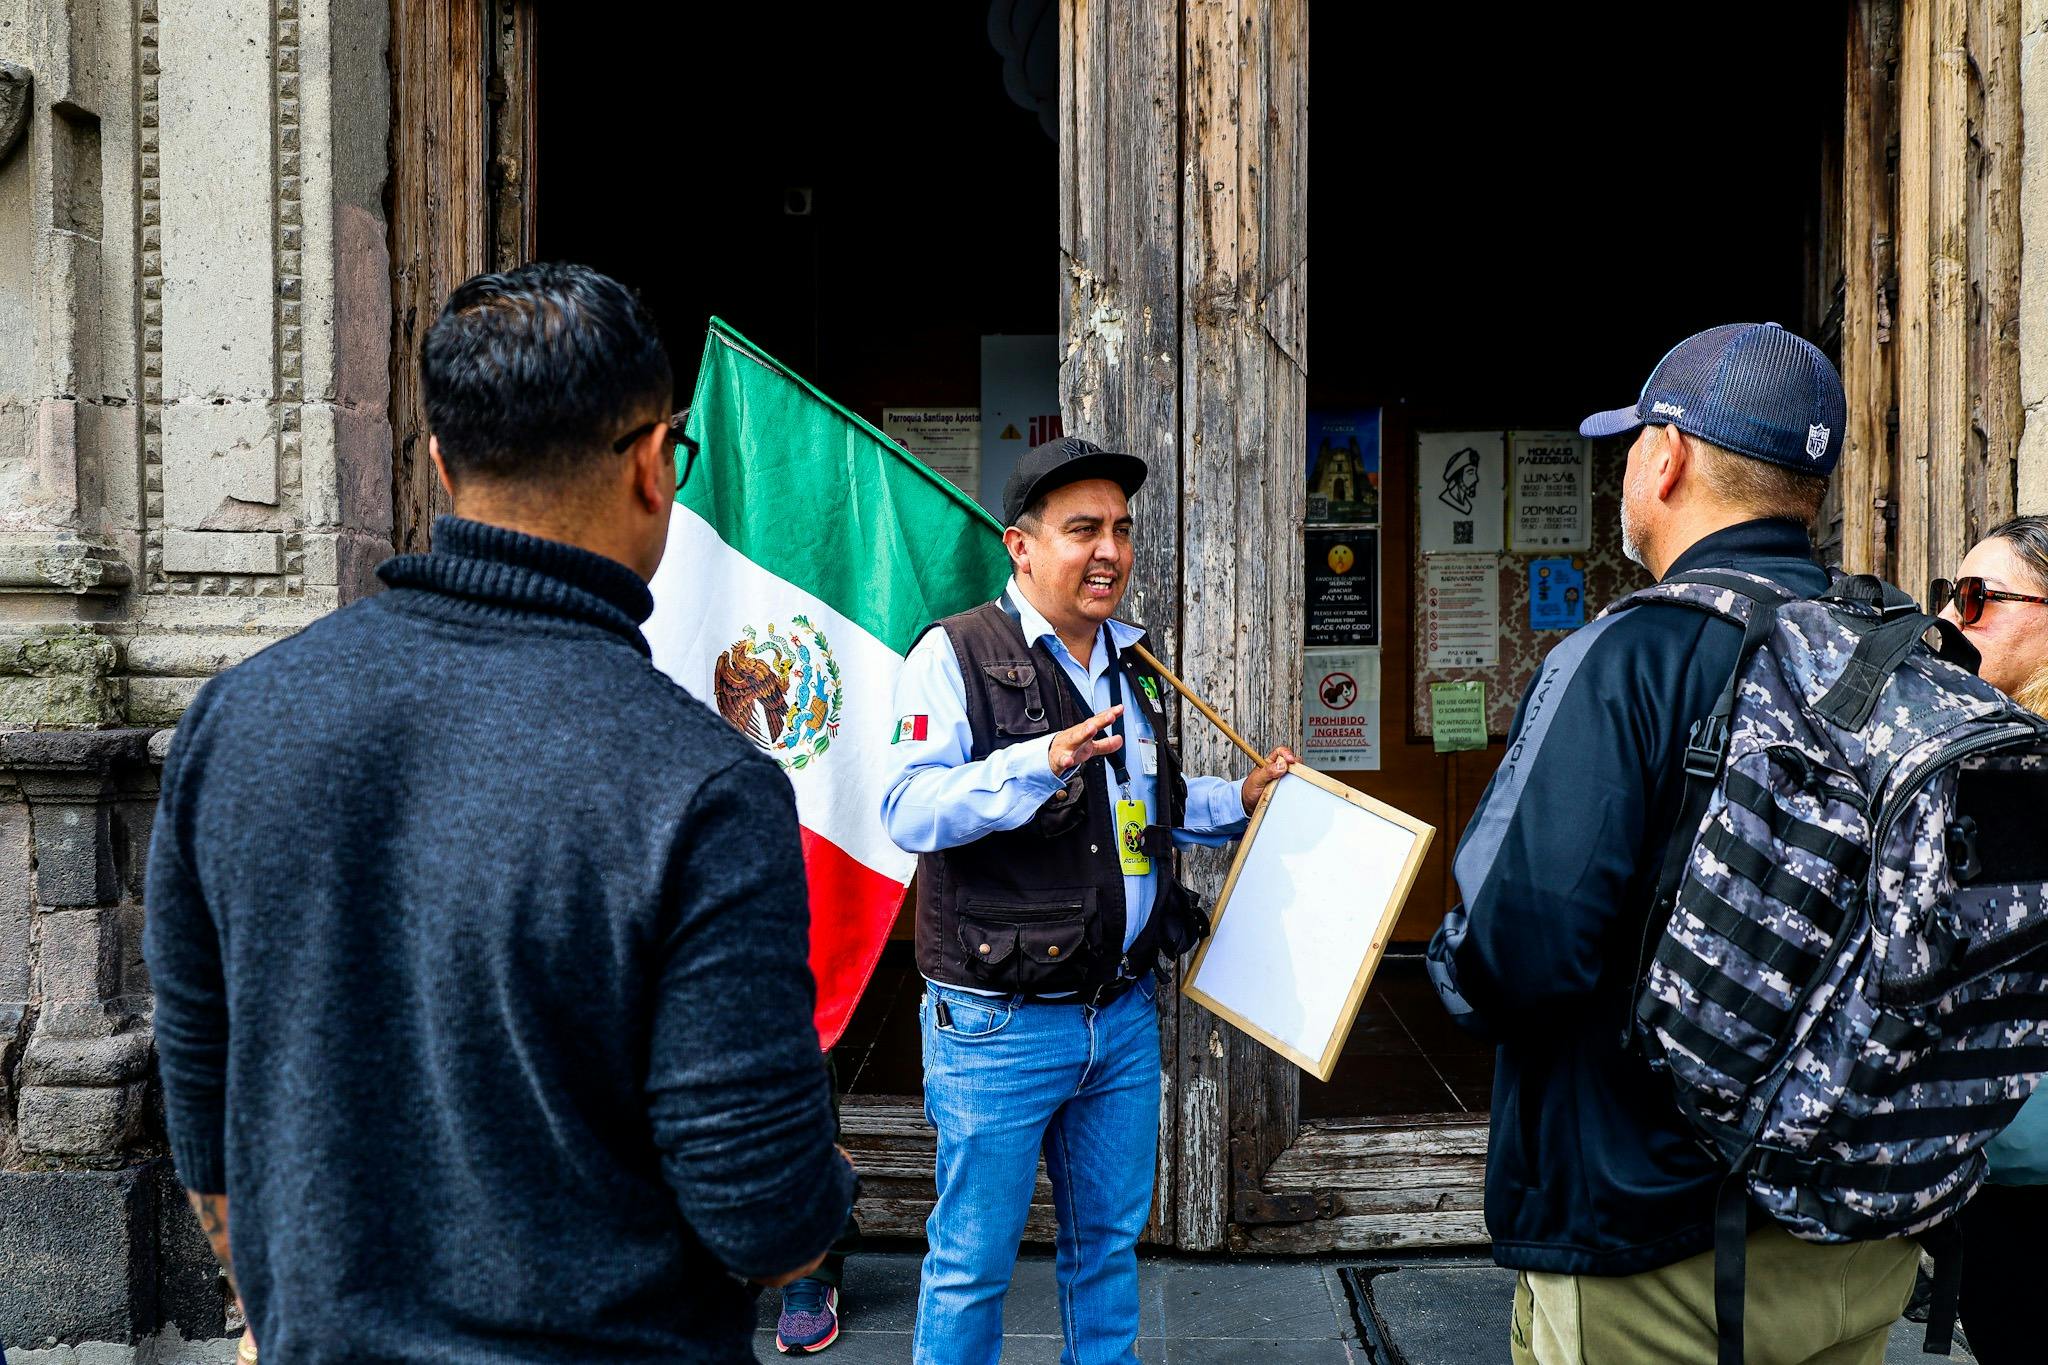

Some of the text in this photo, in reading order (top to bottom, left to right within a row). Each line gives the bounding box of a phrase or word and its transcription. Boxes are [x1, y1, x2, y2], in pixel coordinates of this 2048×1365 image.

[1651, 400, 1685, 419] Reebok
[888, 413, 922, 424] Parroquia
[923, 413, 954, 425] Santiago
[1518, 456, 1581, 465] PARROQUIAL
[1522, 505, 1577, 516] DOMINGO
[1308, 716, 1366, 725] PROHIBIDO
[1314, 728, 1363, 737] INGRESAR
[1305, 738, 1323, 746] CON
